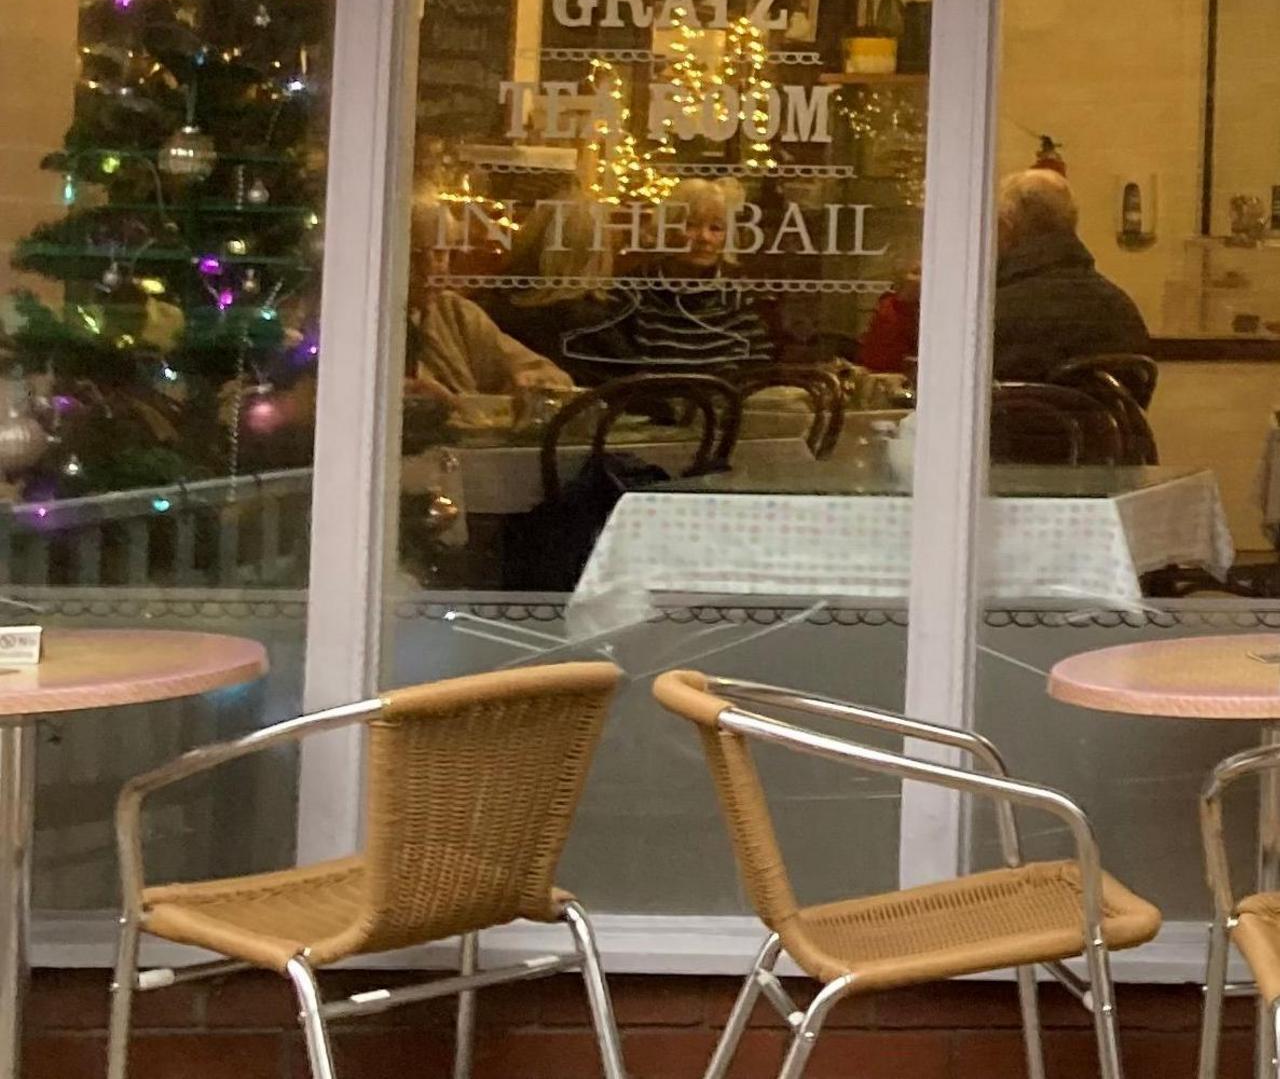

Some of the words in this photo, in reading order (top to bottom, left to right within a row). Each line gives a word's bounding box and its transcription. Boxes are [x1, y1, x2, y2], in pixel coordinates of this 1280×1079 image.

[499, 80, 630, 140] TEA
[647, 83, 842, 144] ROOM
[432, 198, 522, 251] IN
[534, 198, 693, 253] THE
[717, 202, 890, 256] BAIL
